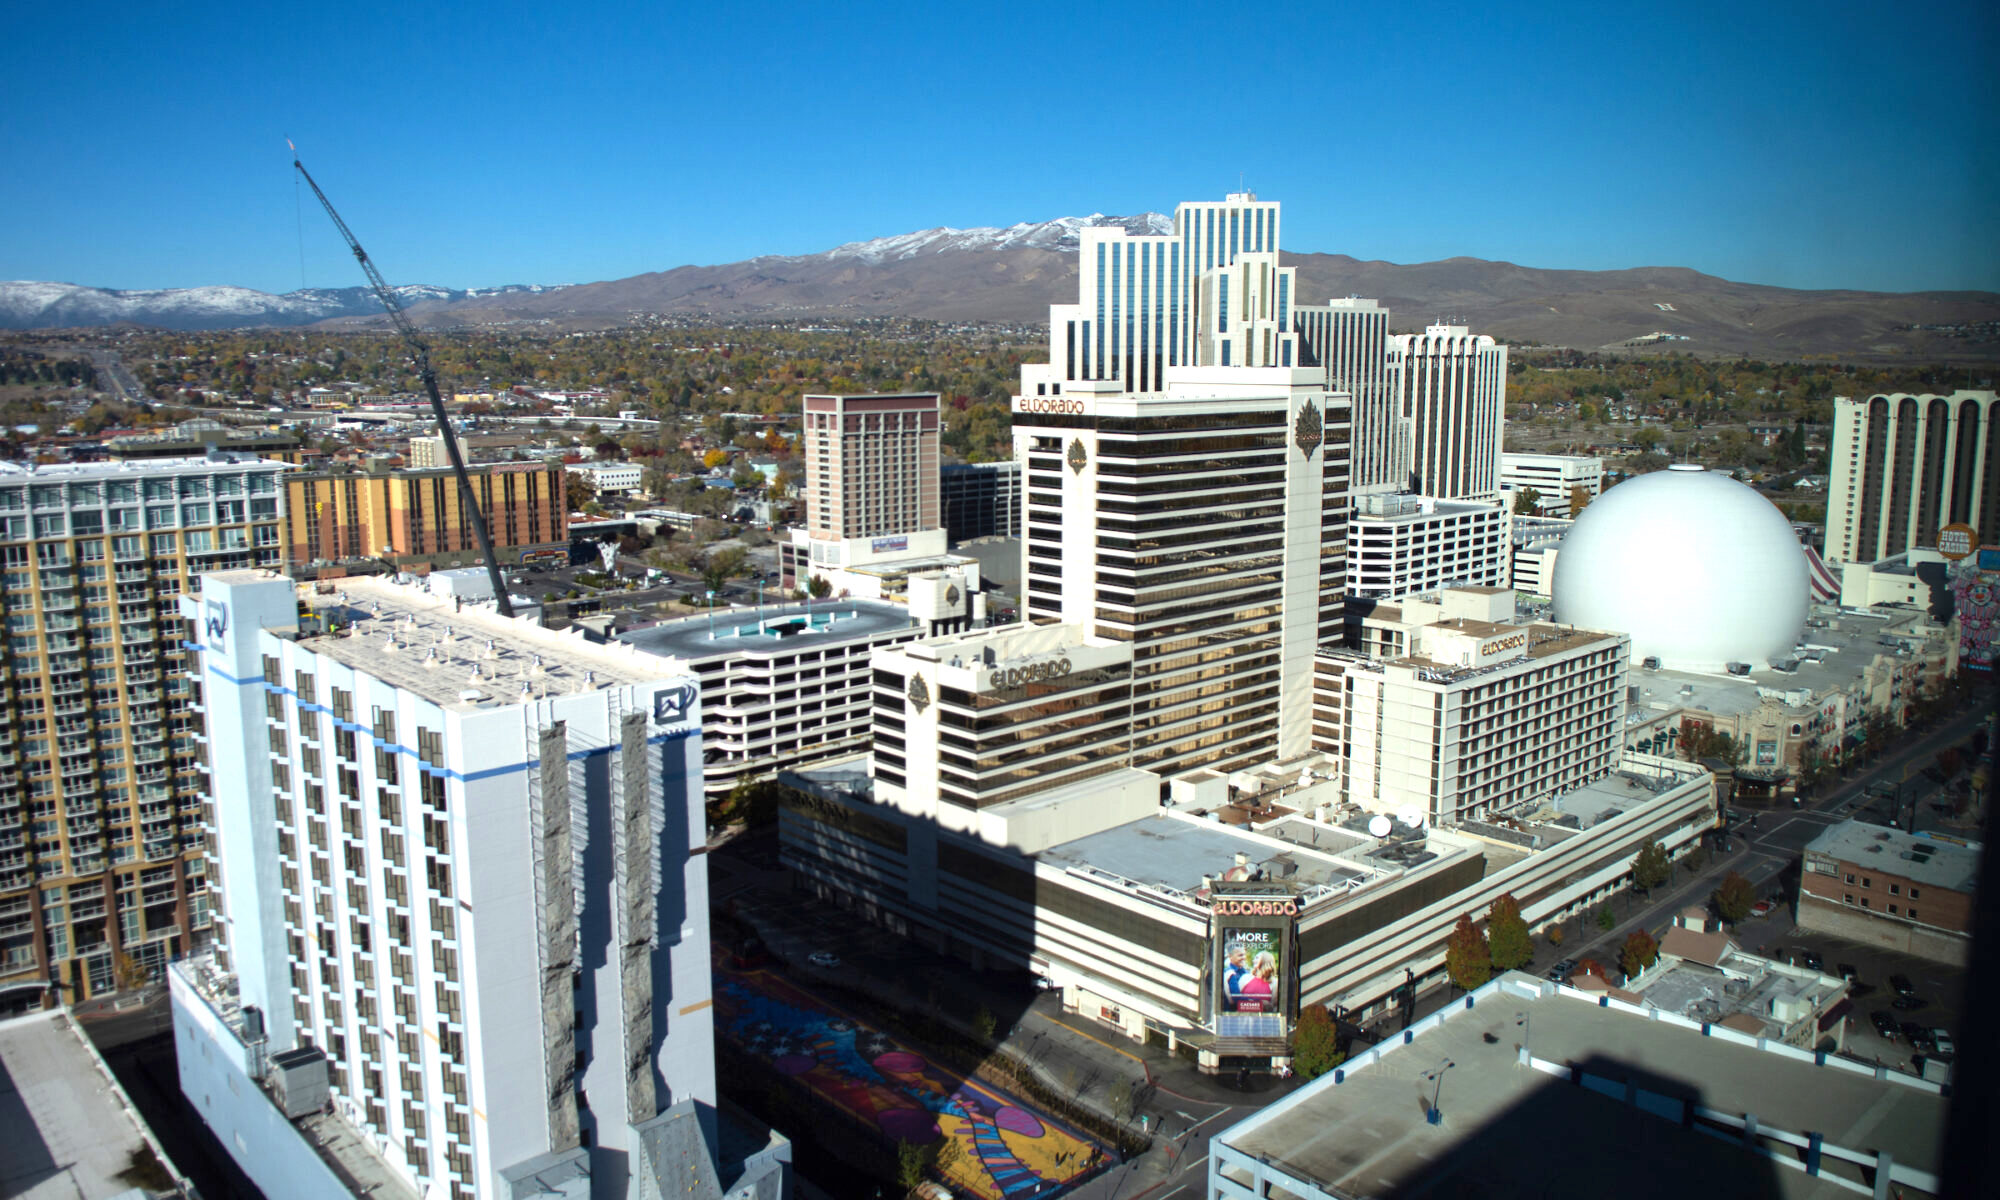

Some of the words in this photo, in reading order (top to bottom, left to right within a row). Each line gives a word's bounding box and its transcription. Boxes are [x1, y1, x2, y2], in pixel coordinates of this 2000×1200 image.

[1020, 398, 1085, 415] ELDORADO
[1942, 530, 1969, 543] HOTEL
[1939, 541, 1969, 554] CASINO
[1213, 901, 1298, 916] ELDORADO
[1236, 932, 1269, 942] MORE
